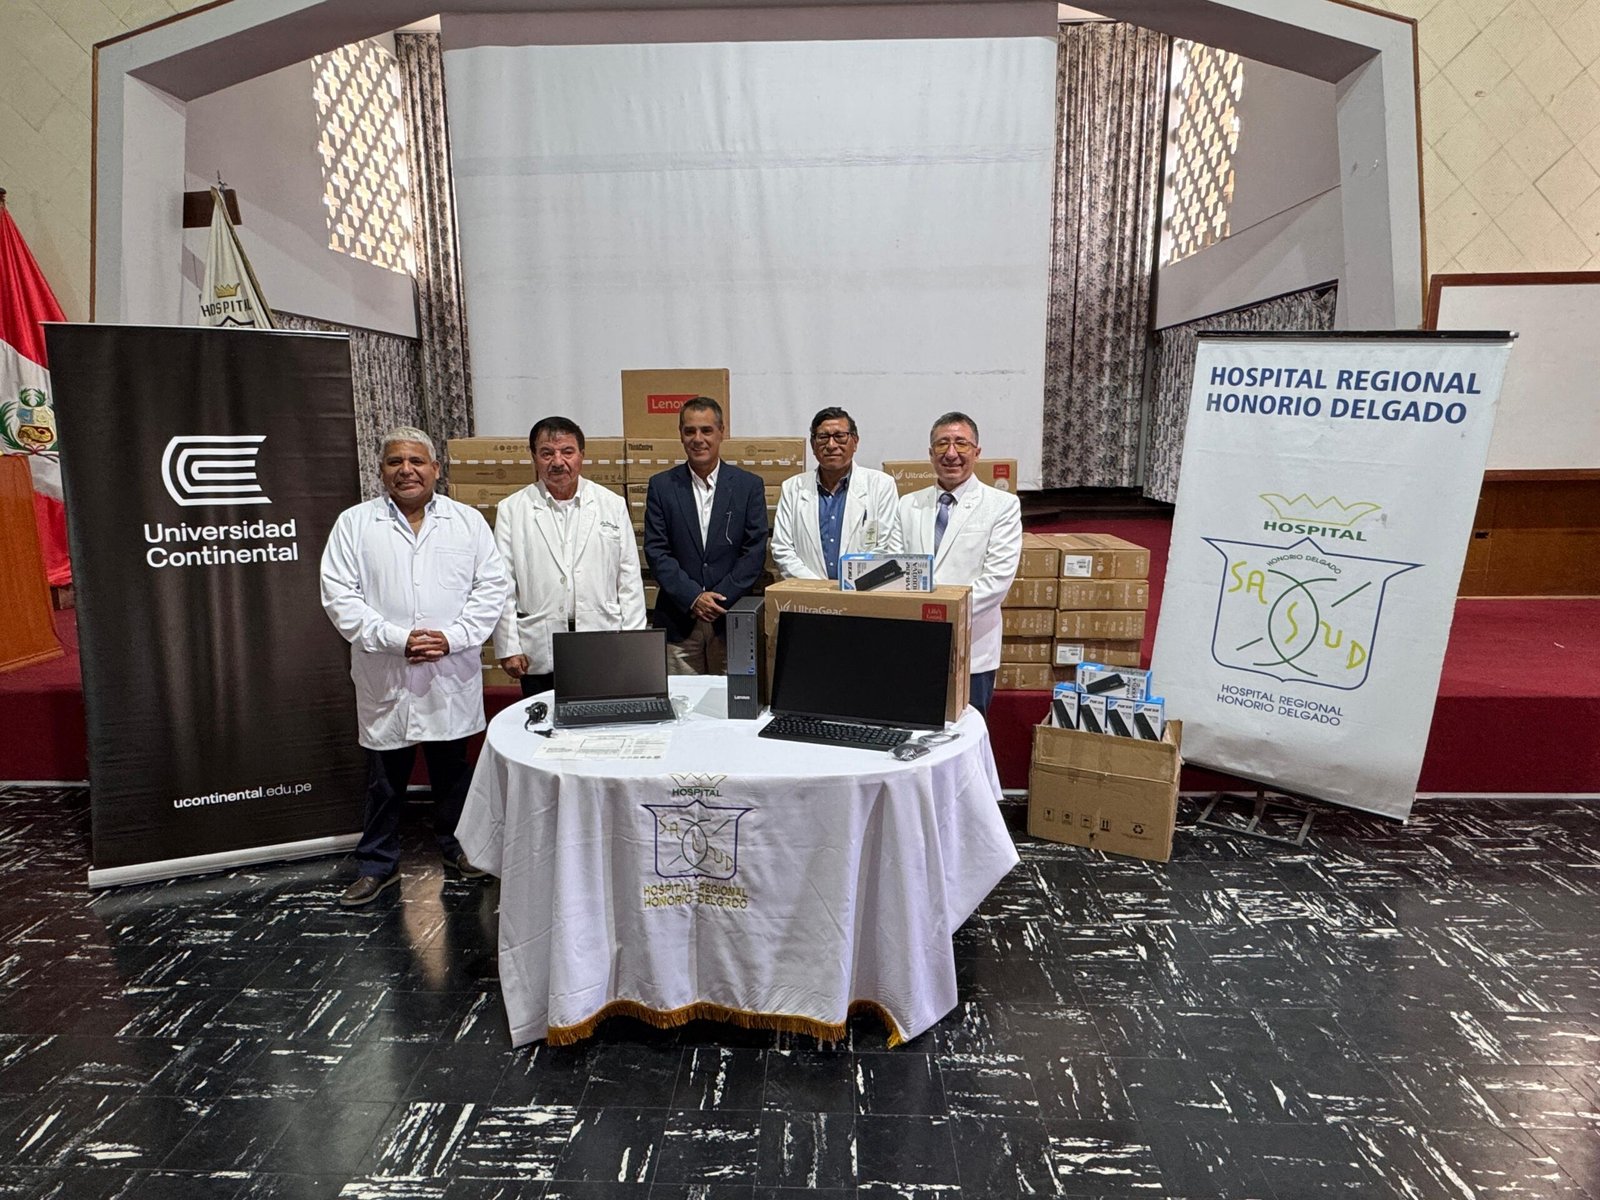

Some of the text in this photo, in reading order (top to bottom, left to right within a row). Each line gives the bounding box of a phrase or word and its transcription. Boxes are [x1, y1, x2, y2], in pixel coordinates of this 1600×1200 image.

[1210, 366, 1481, 394] HOSPITAL REGIONAL
[651, 399, 685, 409] Lenov
[1206, 392, 1467, 424] HONORIO DELGADO
[143, 518, 297, 543] Universidad
[1263, 520, 1367, 542] HOSPITAL
[146, 542, 299, 568] Continental
[1266, 553, 1342, 575] HONORIO DELGADO
[1216, 693, 1341, 726] HONORIO DELGADO
[1221, 683, 1344, 717] HOSPITAL REGIONAL
[173, 782, 312, 809] ucontinental.edu.pe
[672, 788, 722, 797] HOSPITAL
[643, 883, 749, 898] HOSPITAL REGIONAL
[644, 894, 692, 908] HONORIO
